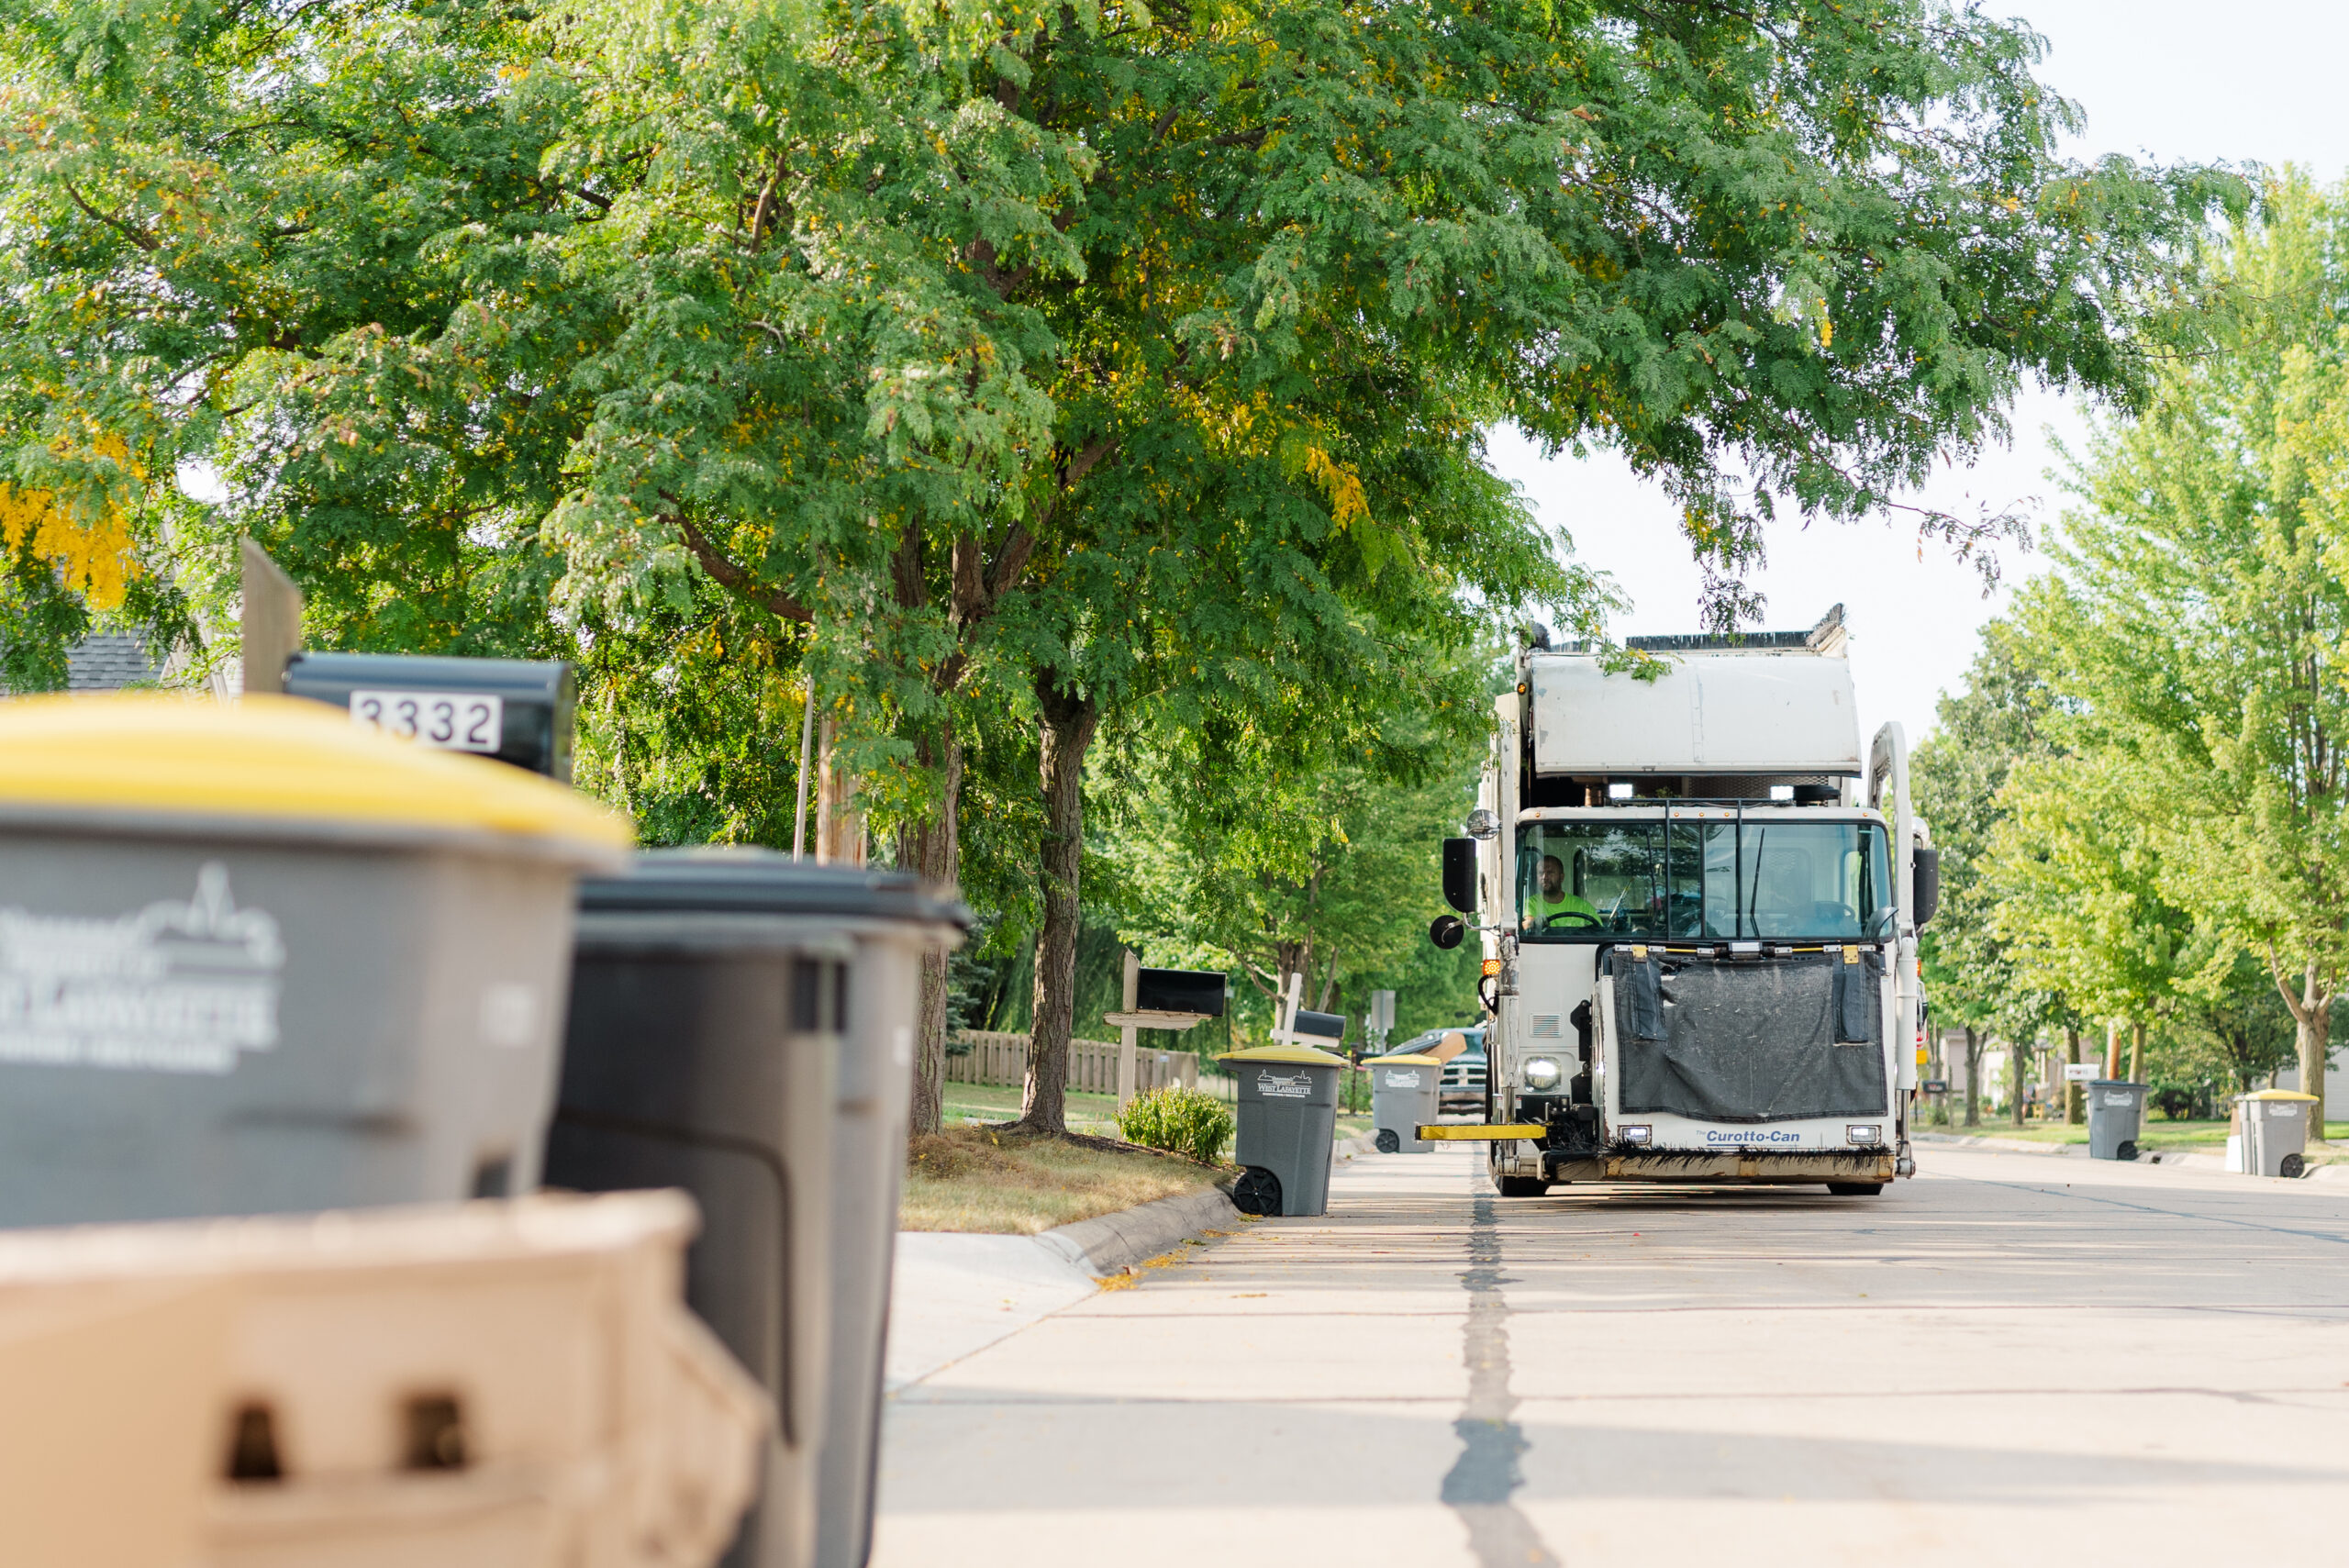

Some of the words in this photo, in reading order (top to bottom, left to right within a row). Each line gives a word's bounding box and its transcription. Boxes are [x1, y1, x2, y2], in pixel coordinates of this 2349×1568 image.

[362, 698, 491, 744] 3332
[1257, 1083, 1276, 1092] WEST
[1276, 1084, 1311, 1095] LAFAYETTE
[1707, 1130, 1800, 1142] Curotto-Can
